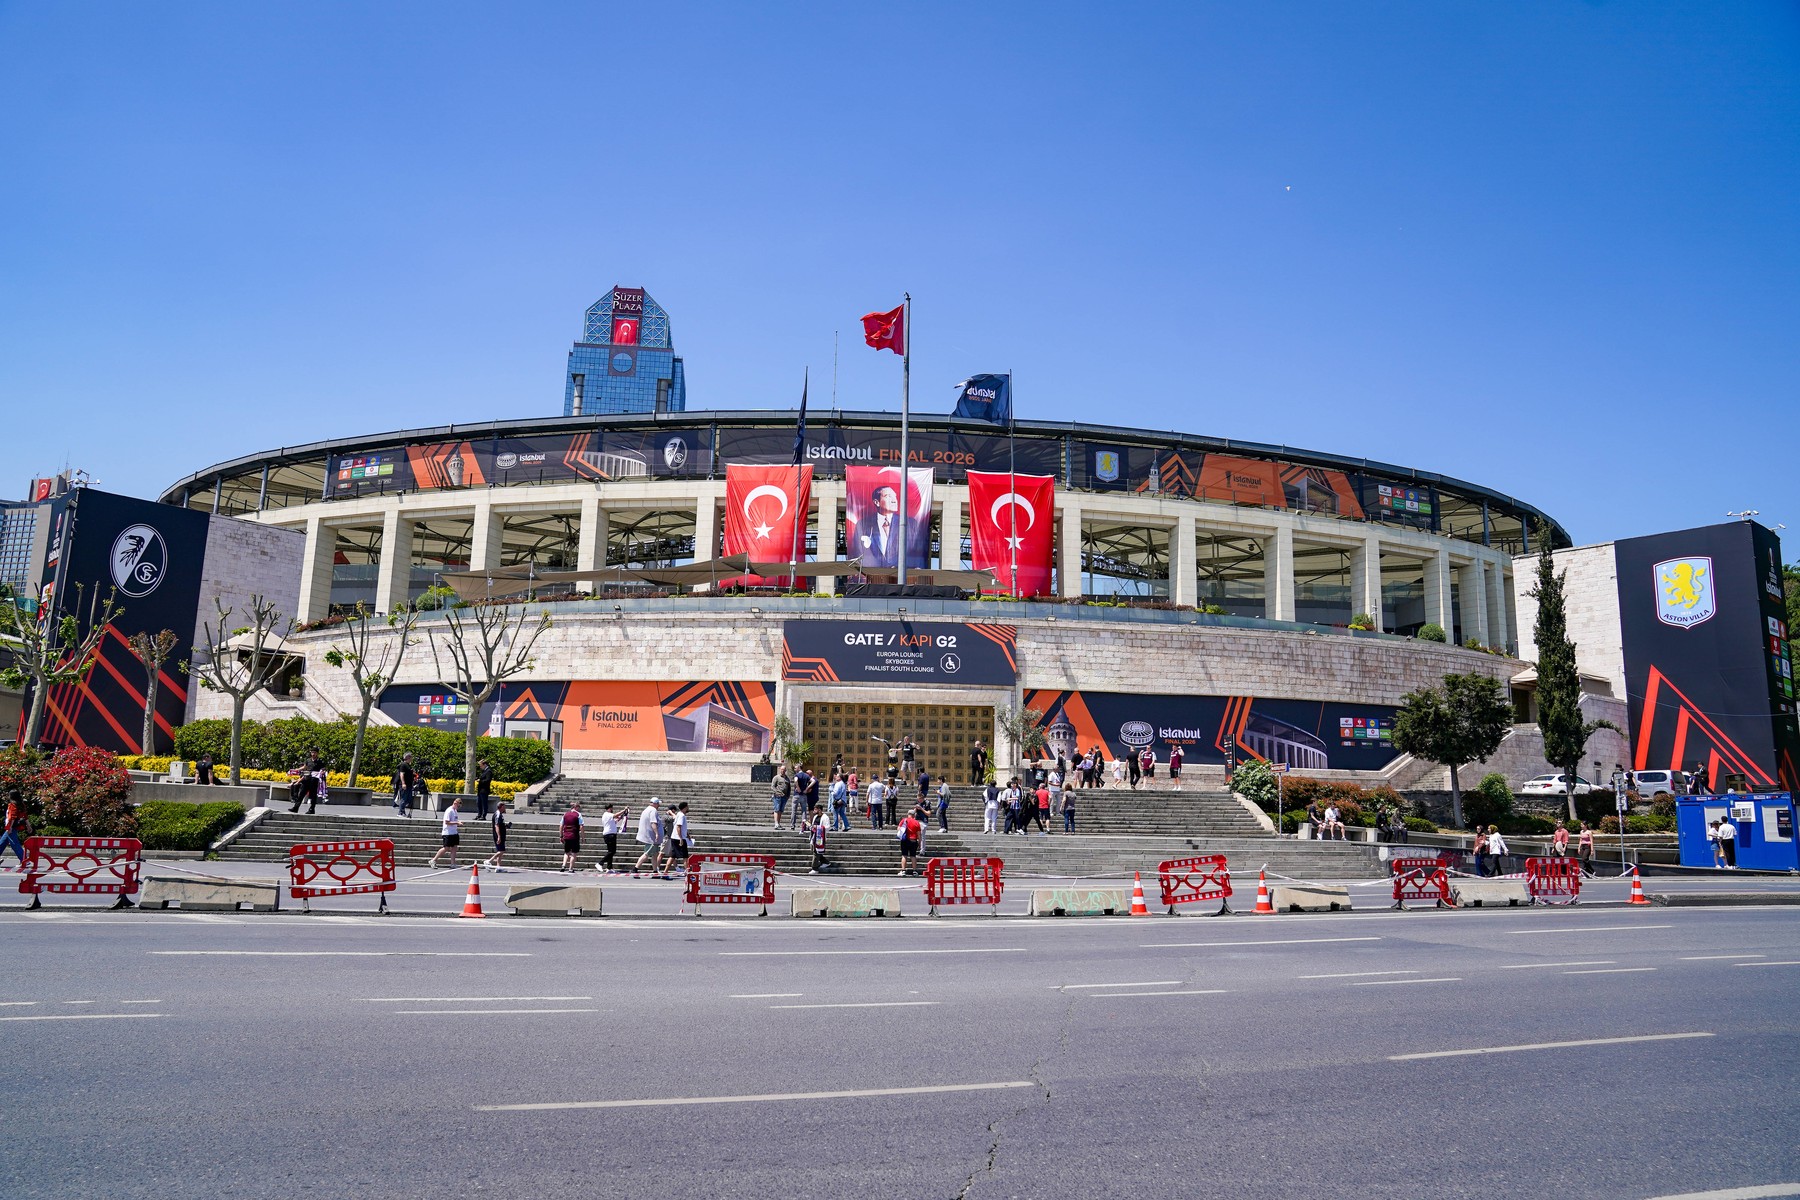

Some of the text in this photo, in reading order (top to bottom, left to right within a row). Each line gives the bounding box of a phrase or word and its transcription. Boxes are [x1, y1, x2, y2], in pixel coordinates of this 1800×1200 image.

[613, 291, 642, 302] SÜZER
[612, 300, 642, 311] PLAZA
[805, 443, 976, 465] Istanbul FINAL 2026
[1663, 609, 1710, 622] ASTON VILLA
[844, 633, 957, 648] GATE / KAPI G2
[592, 709, 638, 722] Istanbul
[1159, 726, 1201, 739] Istanbul
